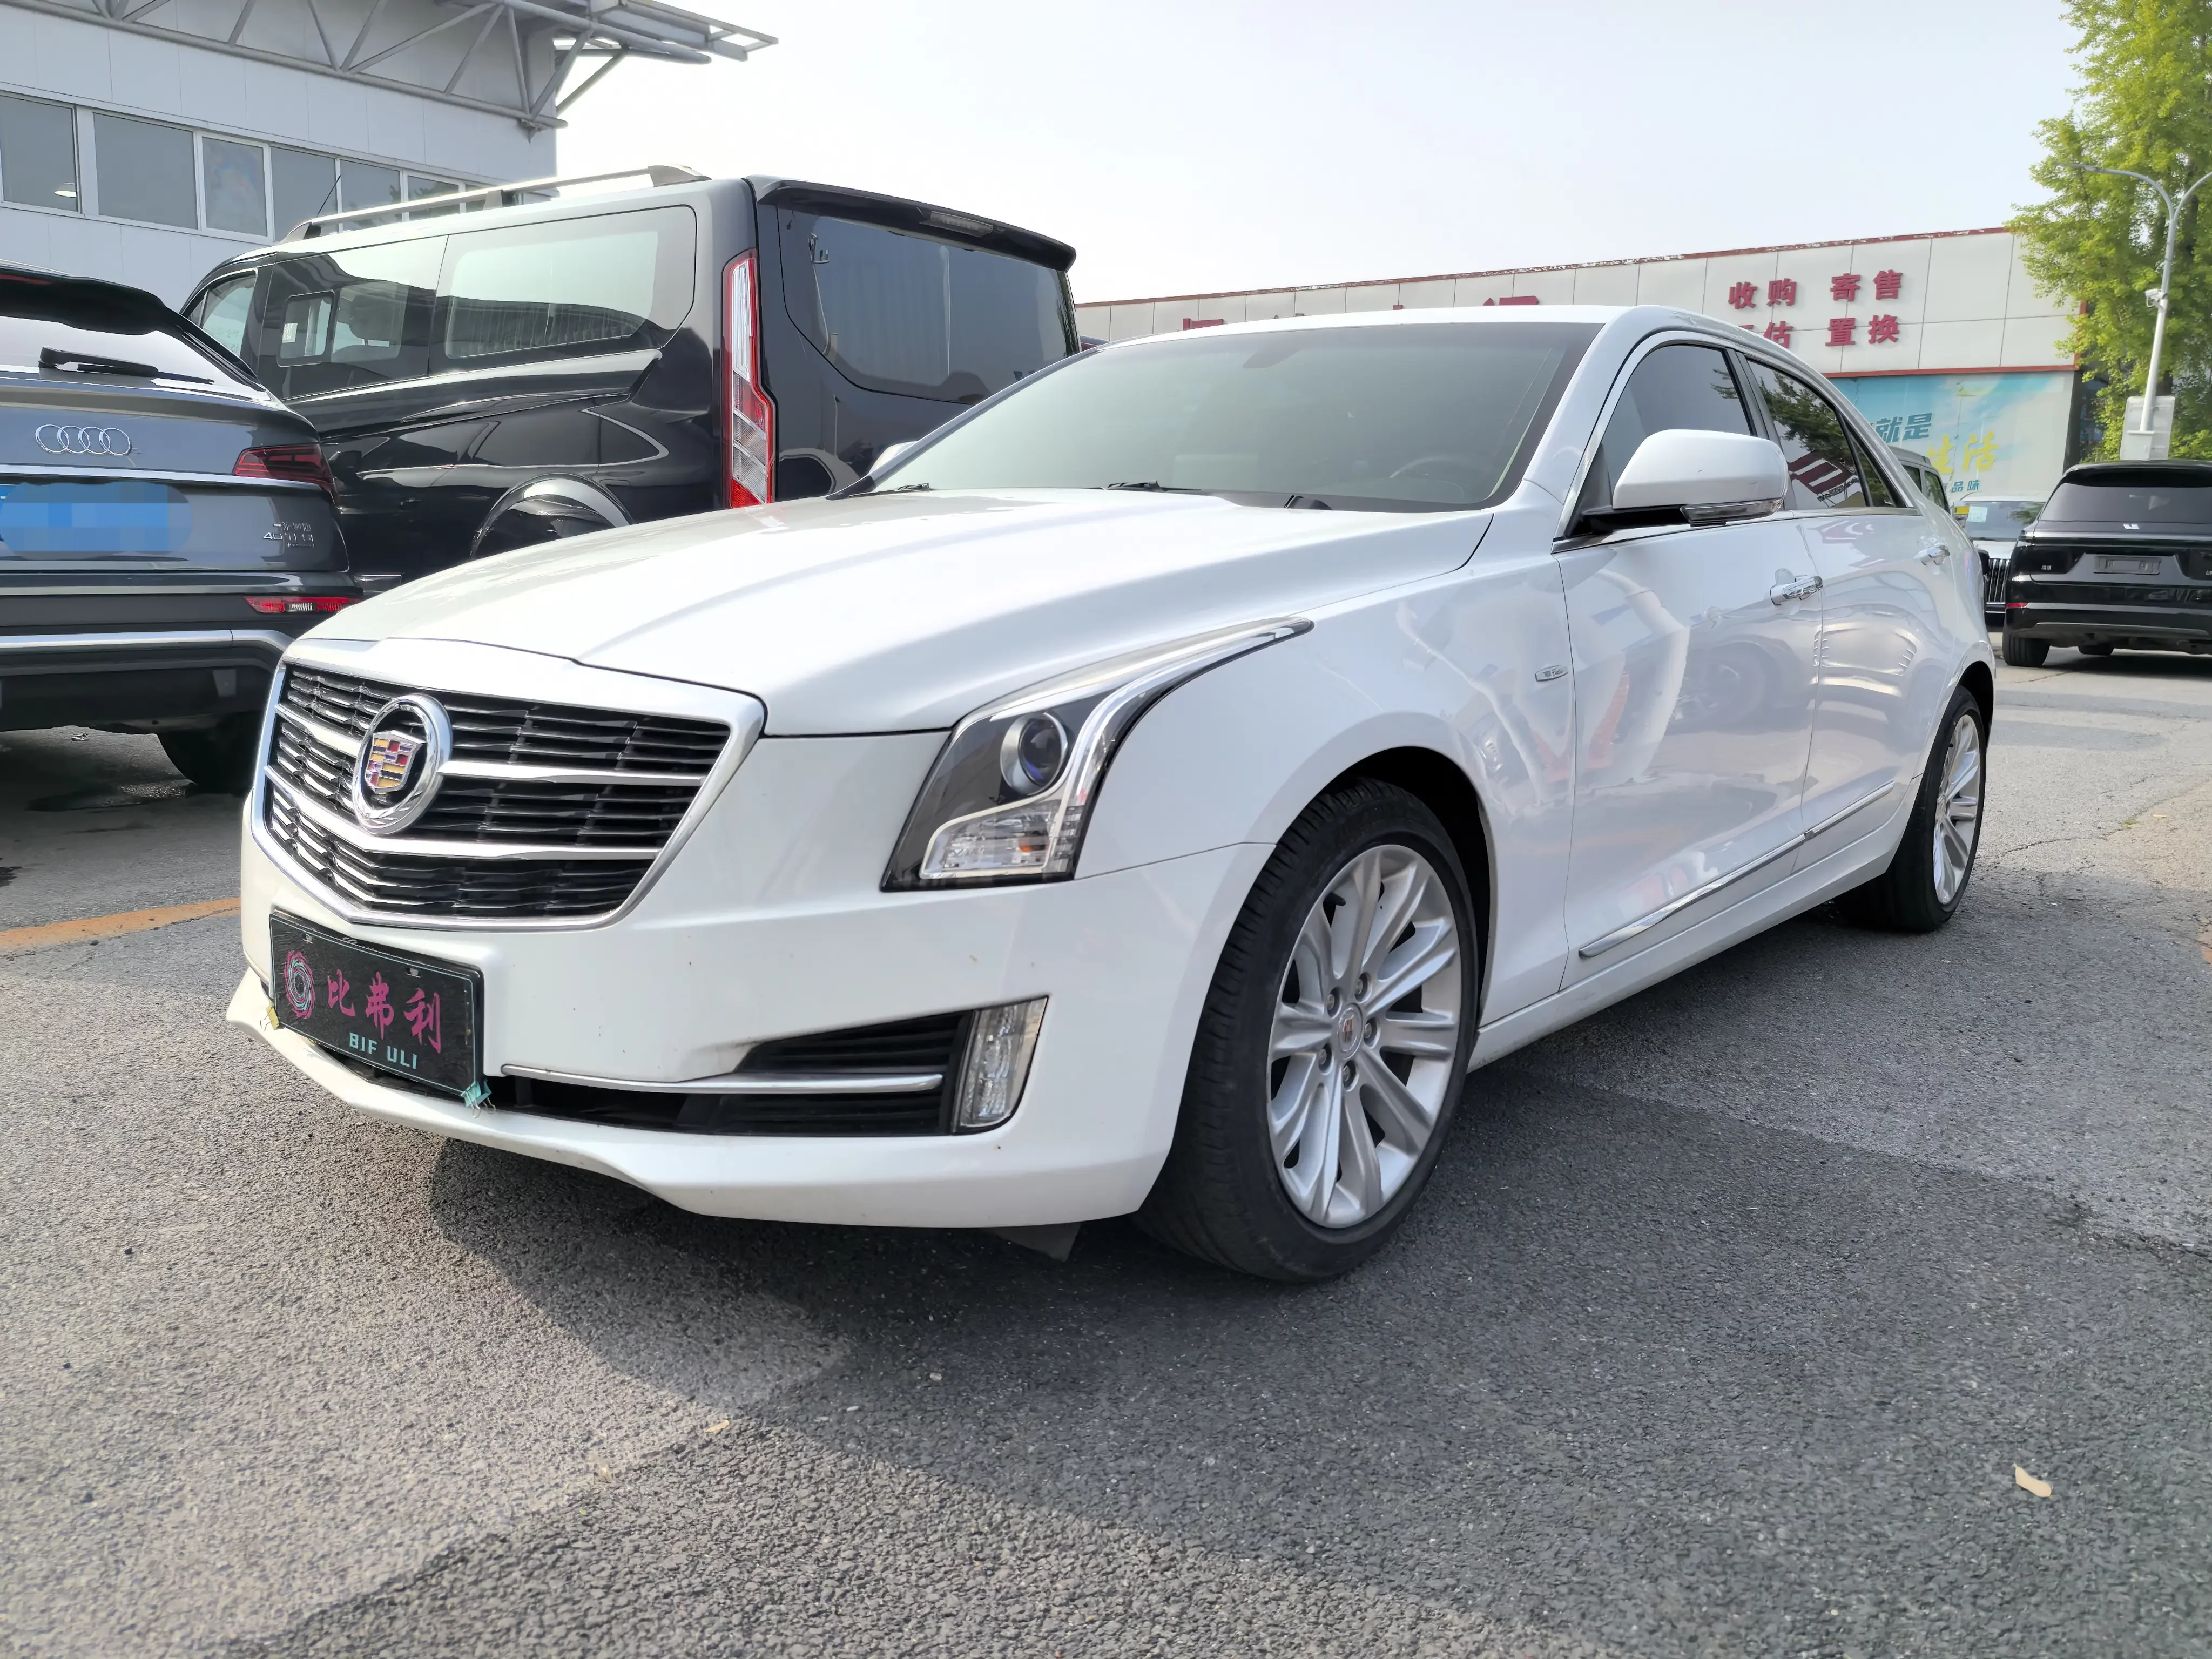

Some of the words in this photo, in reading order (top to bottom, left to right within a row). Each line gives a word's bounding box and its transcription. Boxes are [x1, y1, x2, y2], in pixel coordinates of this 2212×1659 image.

[1728, 278, 1797, 310] 收购
[1830, 269, 1903, 302] 寄售
[1739, 321, 1793, 349] 估
[1825, 314, 1900, 347] 置换
[1870, 412, 1933, 444] 就是
[1927, 430, 2000, 475] 生活
[327, 968, 442, 1055] 比弗利
[349, 1031, 377, 1055] BIF
[386, 1045, 417, 1070] ULI
